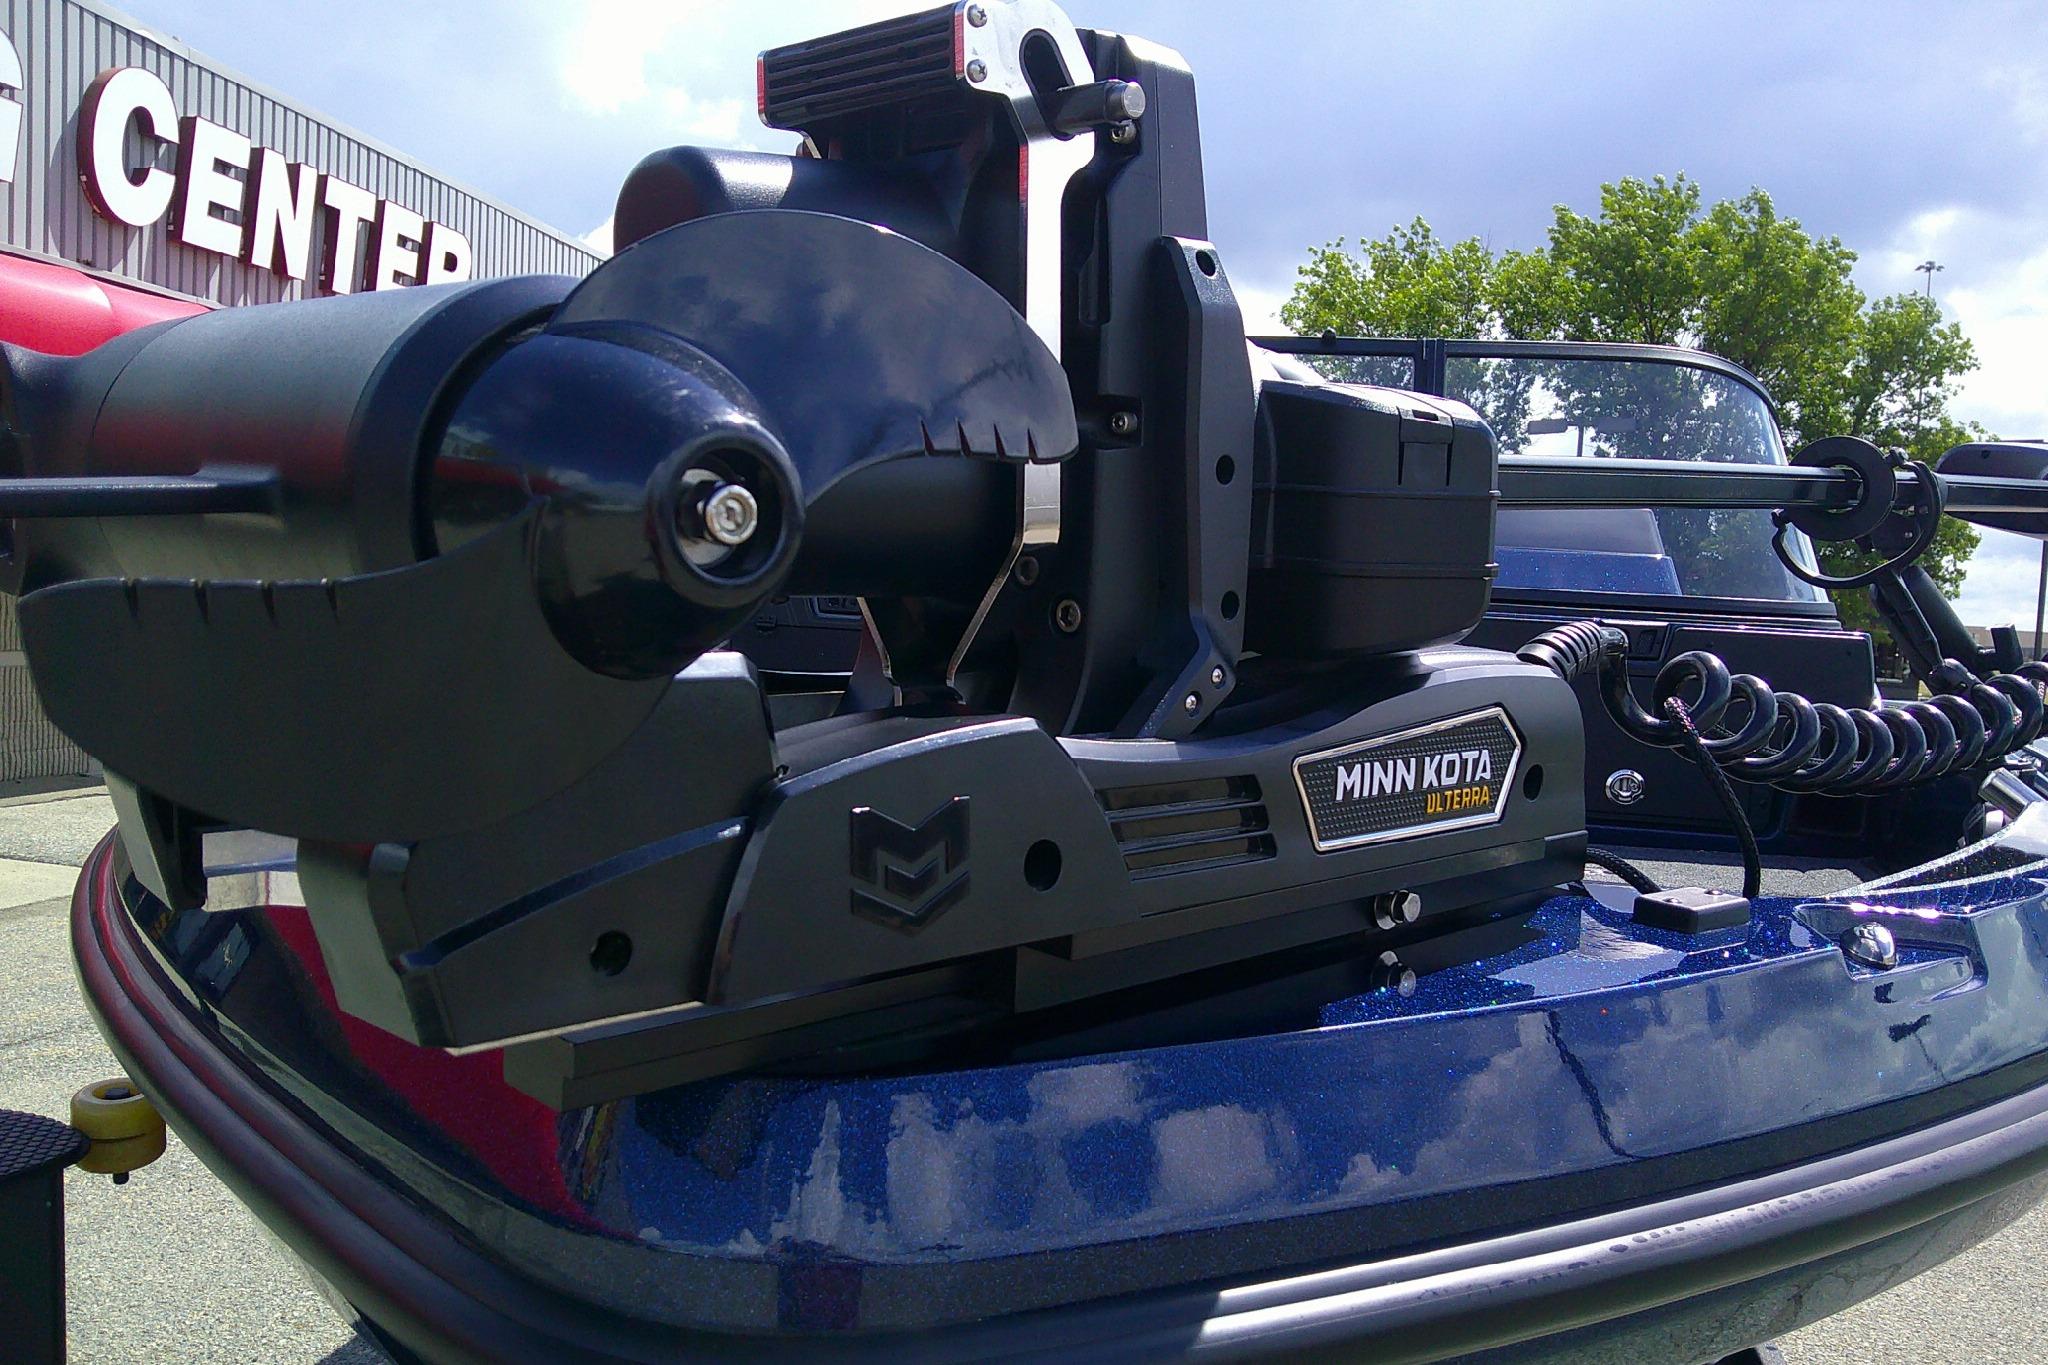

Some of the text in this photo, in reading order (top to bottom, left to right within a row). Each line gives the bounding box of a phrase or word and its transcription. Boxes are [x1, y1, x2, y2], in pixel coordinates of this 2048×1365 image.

[1335, 749, 1492, 802] MINN KOTA
[1426, 785, 1491, 815] ULTERRA
